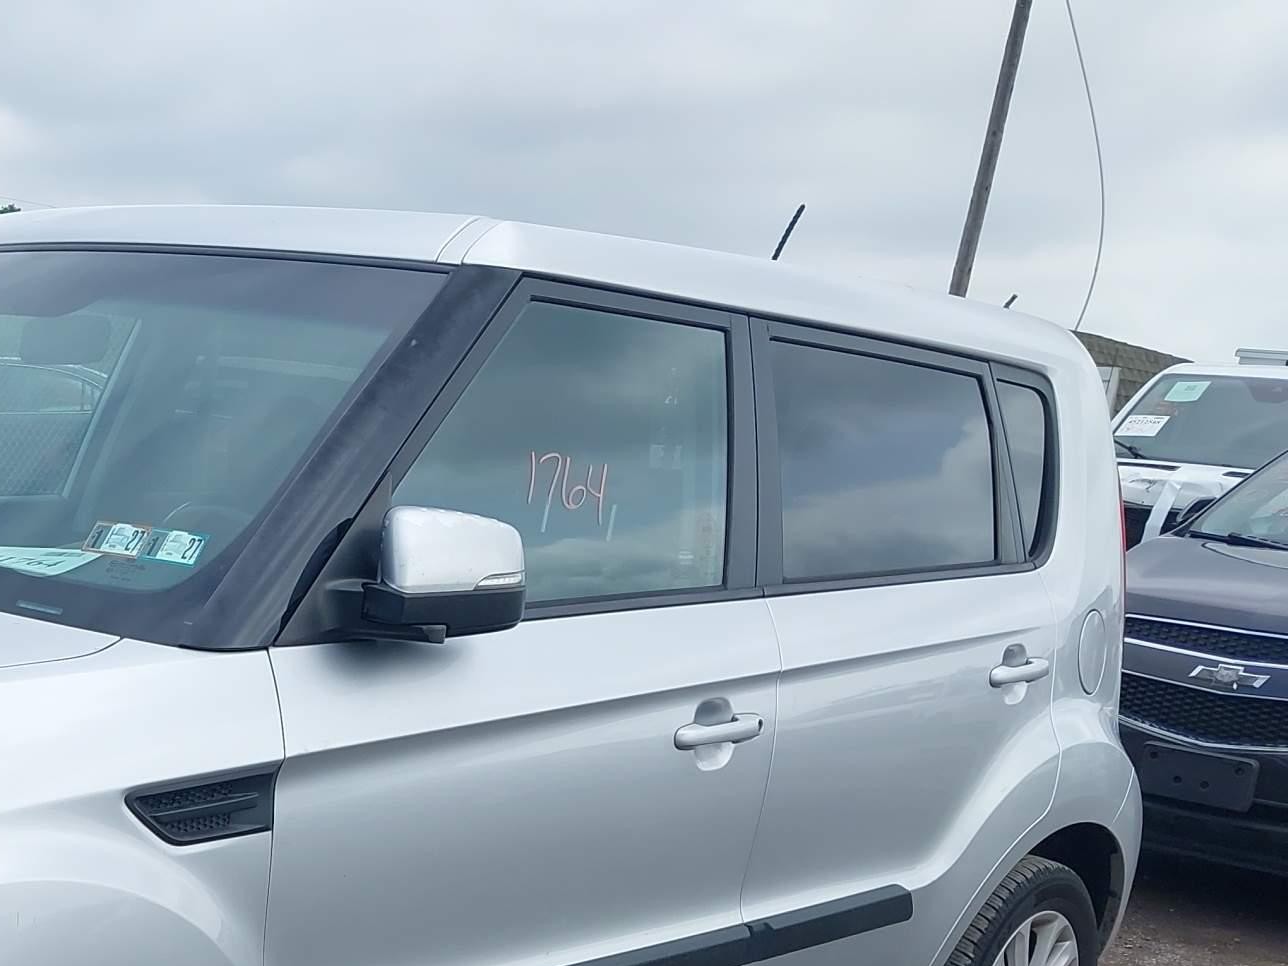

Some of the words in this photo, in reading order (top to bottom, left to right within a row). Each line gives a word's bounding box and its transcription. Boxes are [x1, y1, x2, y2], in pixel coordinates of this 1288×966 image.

[526, 450, 608, 533] 1764
[124, 529, 146, 554] 27
[180, 537, 203, 562] 27
